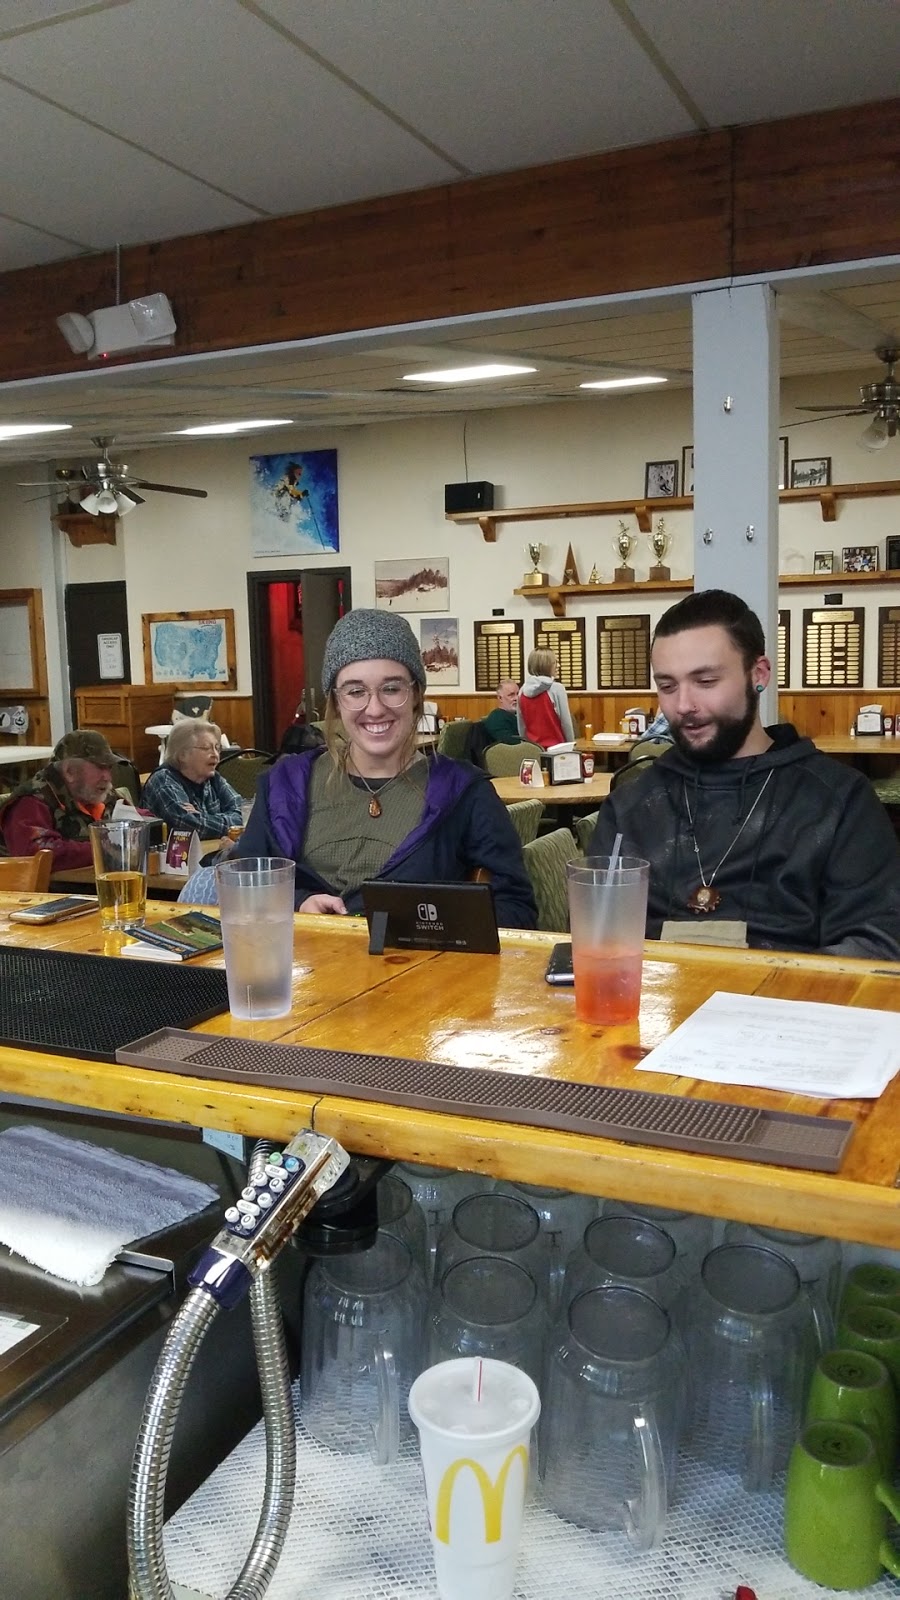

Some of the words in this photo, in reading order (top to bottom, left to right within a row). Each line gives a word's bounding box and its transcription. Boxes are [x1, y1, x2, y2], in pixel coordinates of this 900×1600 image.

[271, 1178, 280, 1187] Q
[243, 1188, 252, 1196] M
[227, 1209, 234, 1217] T
